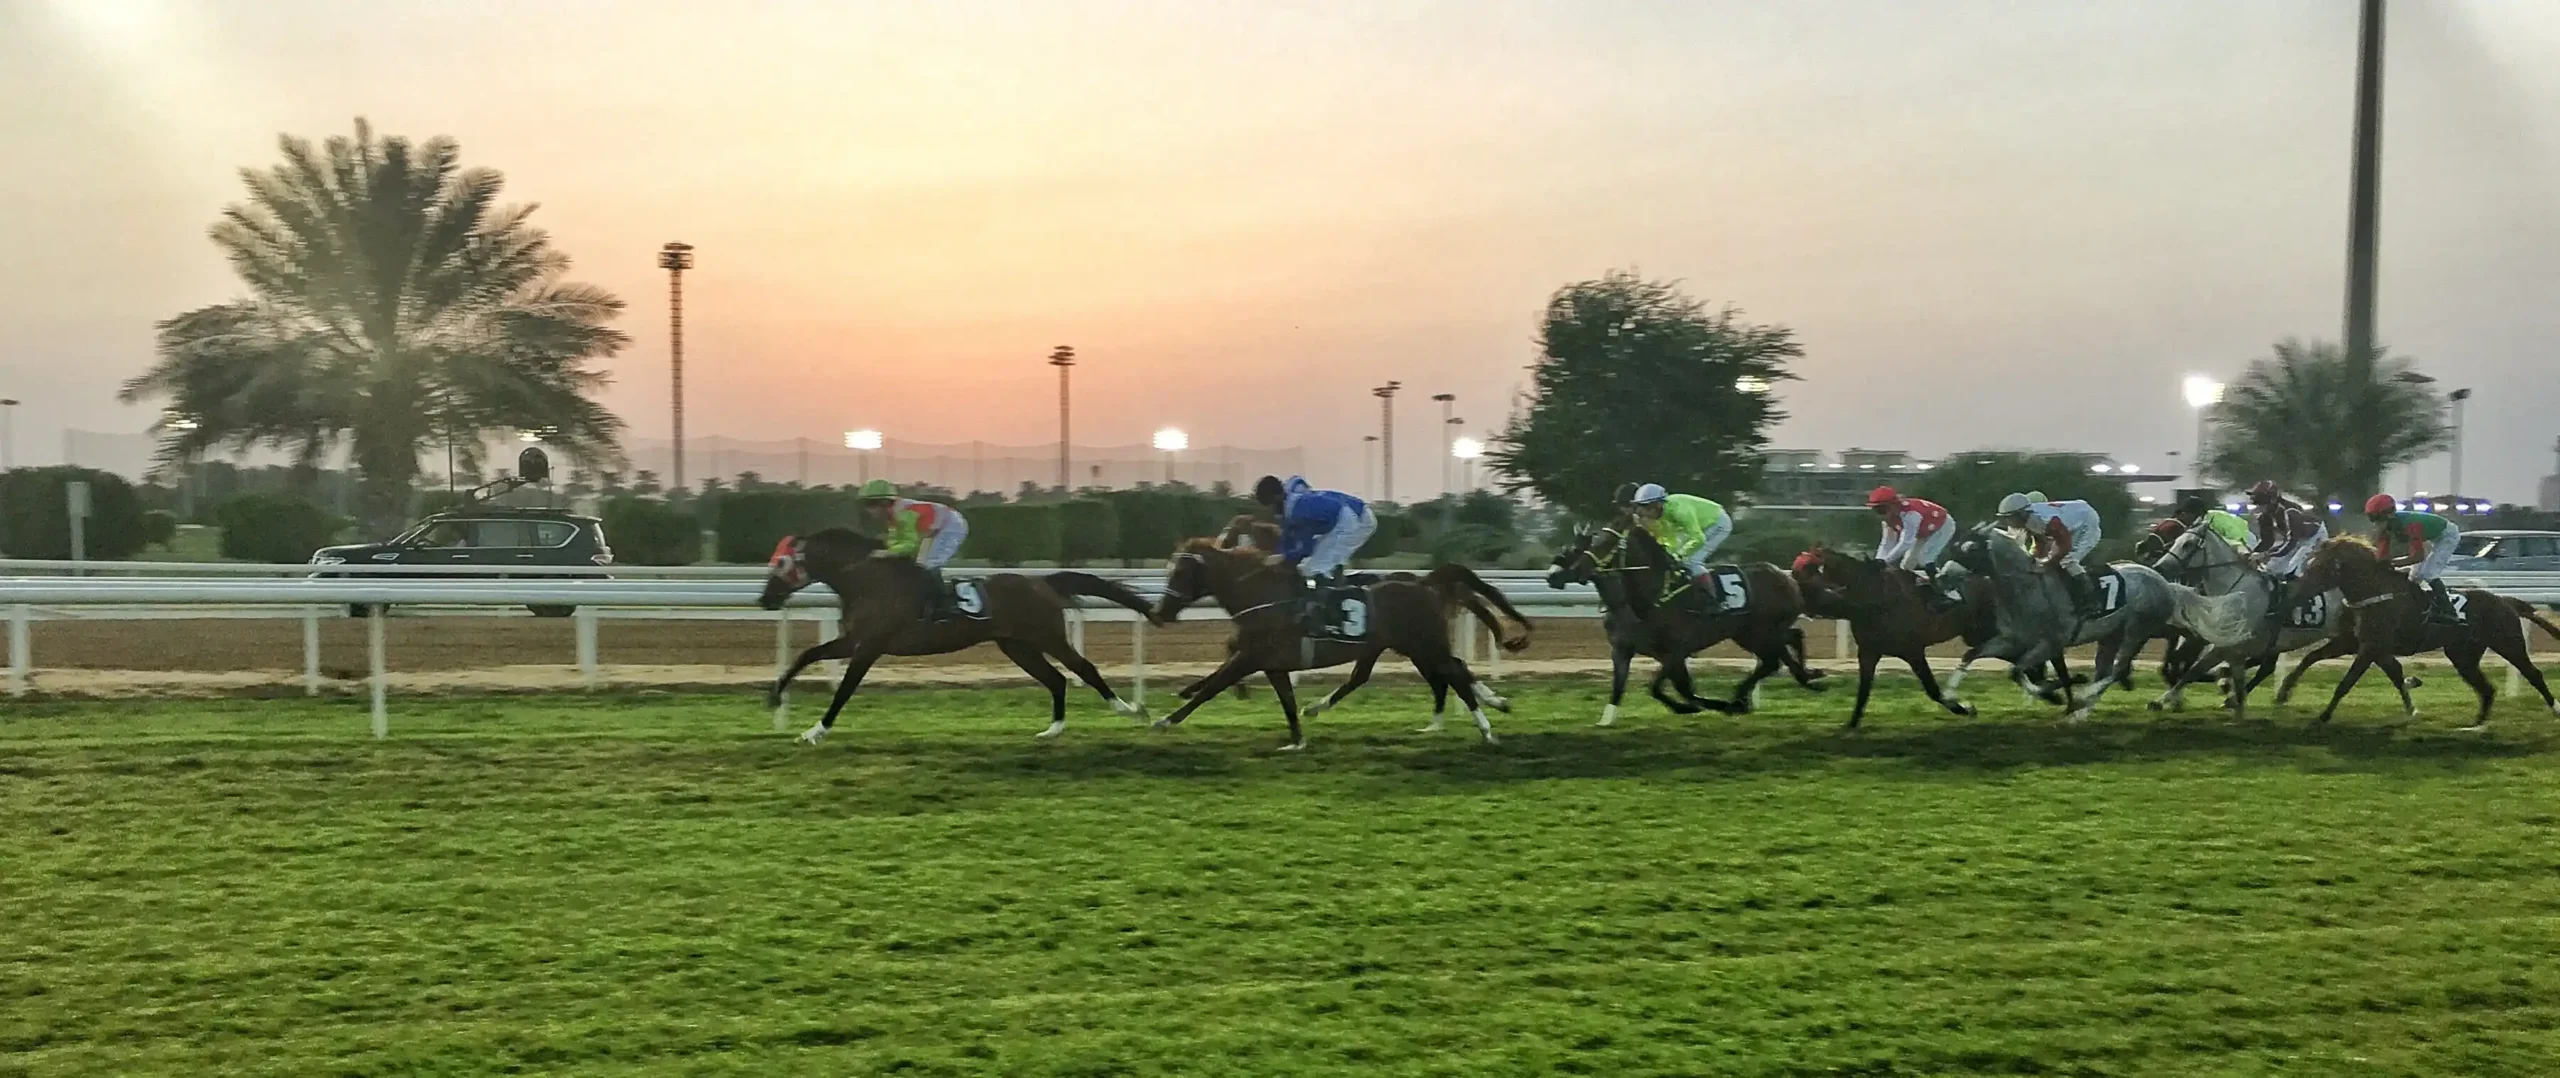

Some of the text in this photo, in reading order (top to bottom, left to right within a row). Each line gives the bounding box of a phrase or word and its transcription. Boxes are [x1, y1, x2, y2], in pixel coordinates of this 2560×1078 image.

[1718, 574, 1746, 608] 5
[2099, 575, 2119, 610] 7
[1341, 598, 1367, 636] 3
